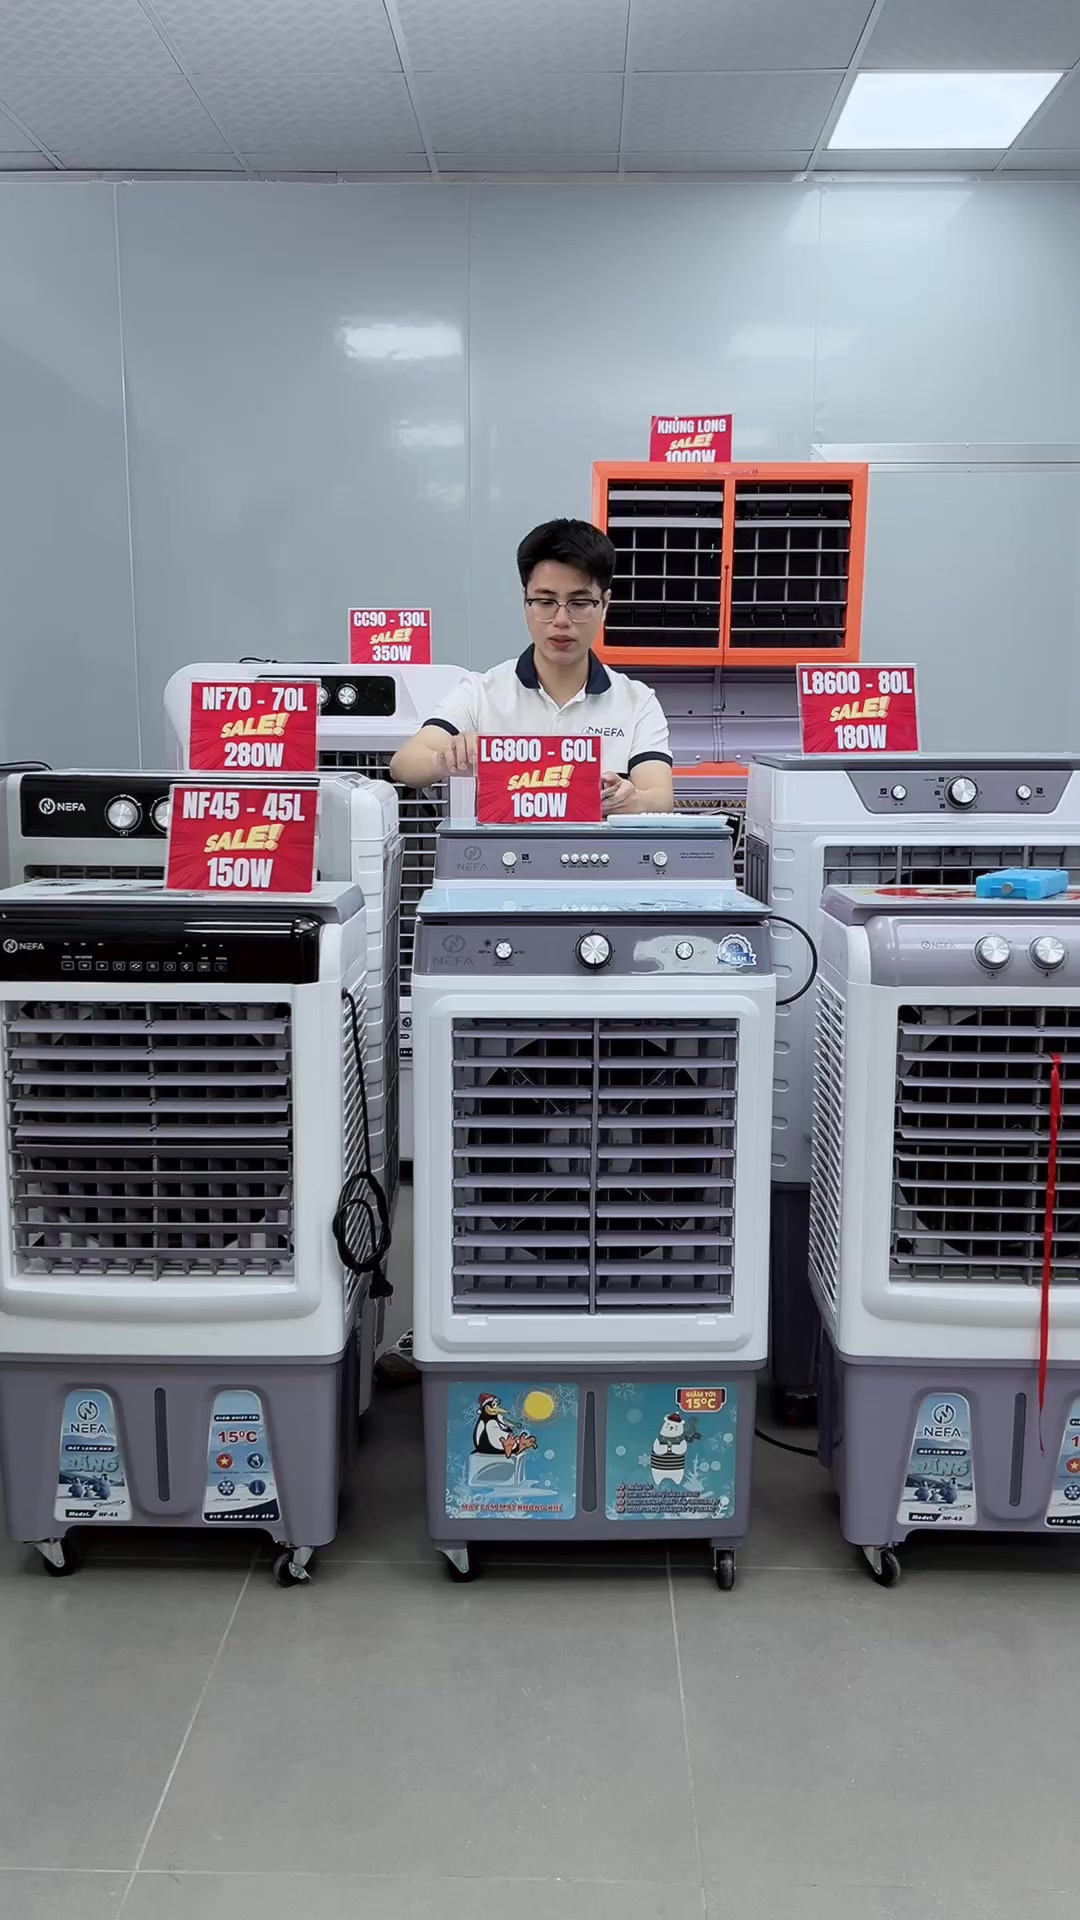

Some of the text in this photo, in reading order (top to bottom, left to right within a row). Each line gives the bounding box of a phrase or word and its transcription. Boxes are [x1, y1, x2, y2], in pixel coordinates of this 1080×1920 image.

[657, 416, 727, 434] KHỦNG LONG
[669, 433, 714, 450] SALE!
[665, 449, 717, 463] 1000W
[353, 611, 387, 627] CC90
[398, 611, 428, 627] 130L
[369, 627, 413, 645] SALE!
[372, 645, 412, 662] 350W
[802, 670, 860, 695] L8600
[878, 670, 913, 694] 80L
[202, 686, 252, 711] NF70
[271, 687, 308, 712] 70L
[829, 695, 891, 722] SALE!
[220, 712, 290, 739] SALE!
[594, 726, 625, 737] NEFA
[834, 724, 887, 749] 180W
[223, 742, 285, 767] 280W
[480, 738, 542, 763] L6800
[561, 738, 597, 763] 60L
[507, 764, 575, 791] SALE!
[57, 802, 86, 811] NEFA
[182, 791, 240, 820] NF45
[262, 793, 305, 822] 45L
[511, 792, 568, 818] 160W
[203, 823, 285, 853] SALE!
[207, 857, 274, 888] 150W
[456, 863, 488, 871] NEFA
[19, 942, 45, 951] NEFA
[433, 956, 474, 966] NEFA
[70, 1423, 107, 1434] NEFA
[924, 1427, 961, 1438] NEFA
